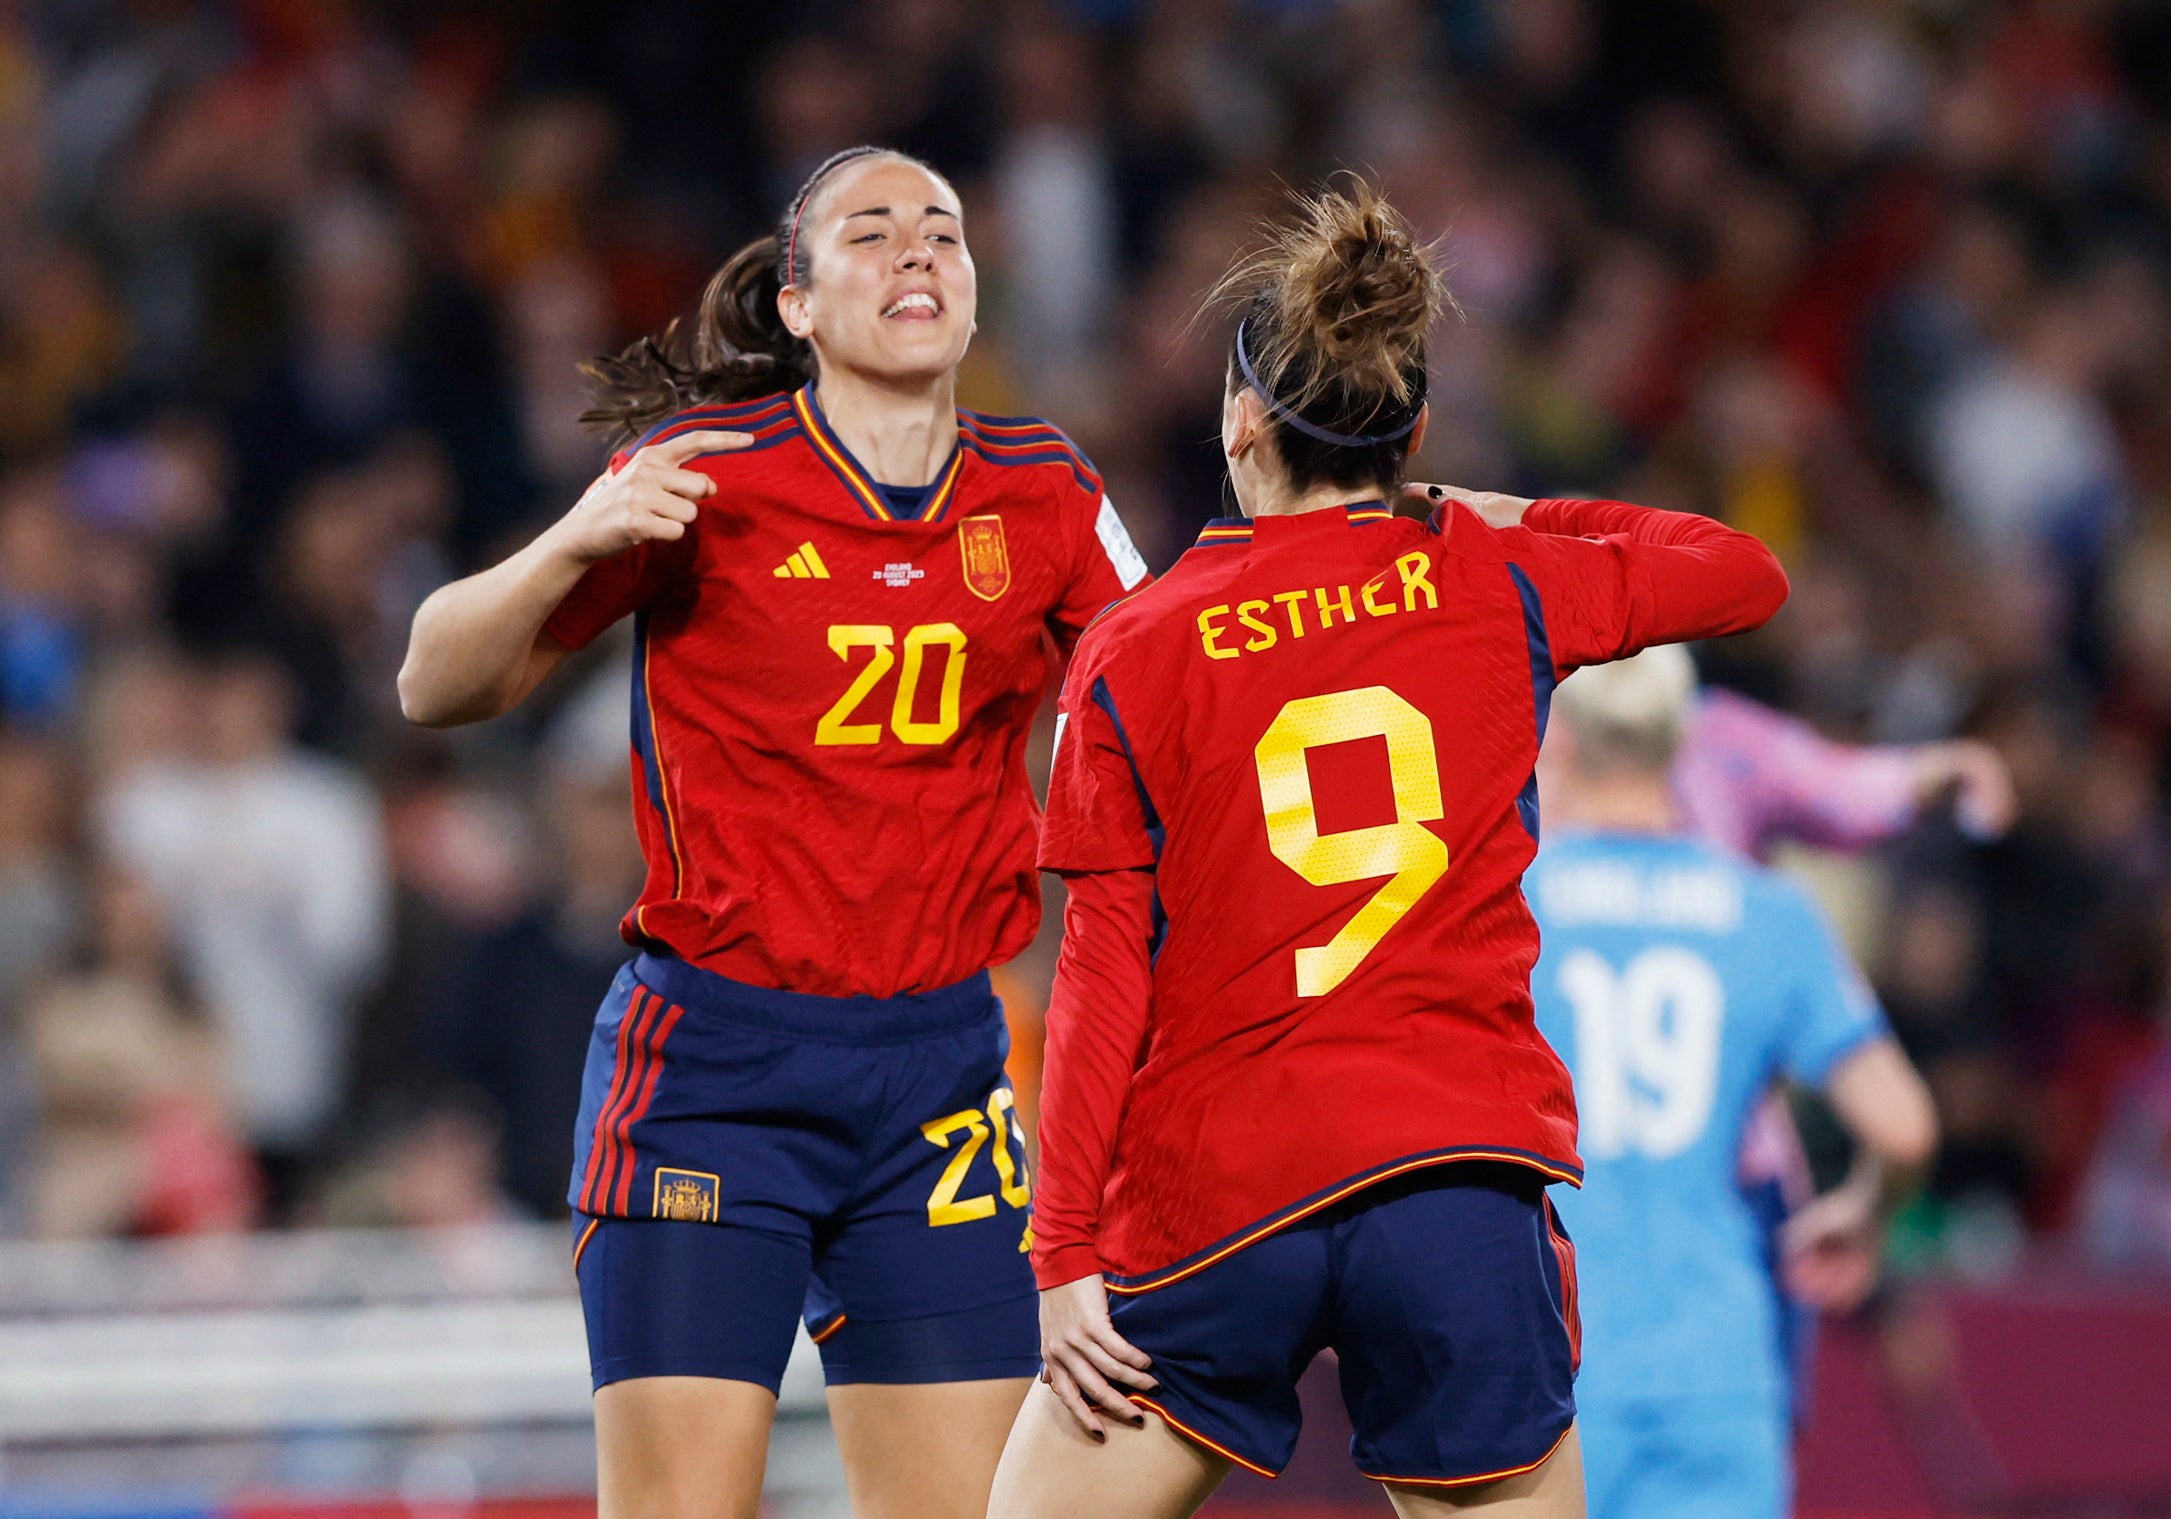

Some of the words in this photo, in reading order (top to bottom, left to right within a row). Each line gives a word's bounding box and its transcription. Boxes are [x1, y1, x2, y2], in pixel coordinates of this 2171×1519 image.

[1198, 551, 1438, 660] ESTHER
[814, 622, 968, 745] 20
[1254, 685, 1449, 998] 9
[1556, 945, 1726, 1160] 19
[919, 1087, 1032, 1228] 20
